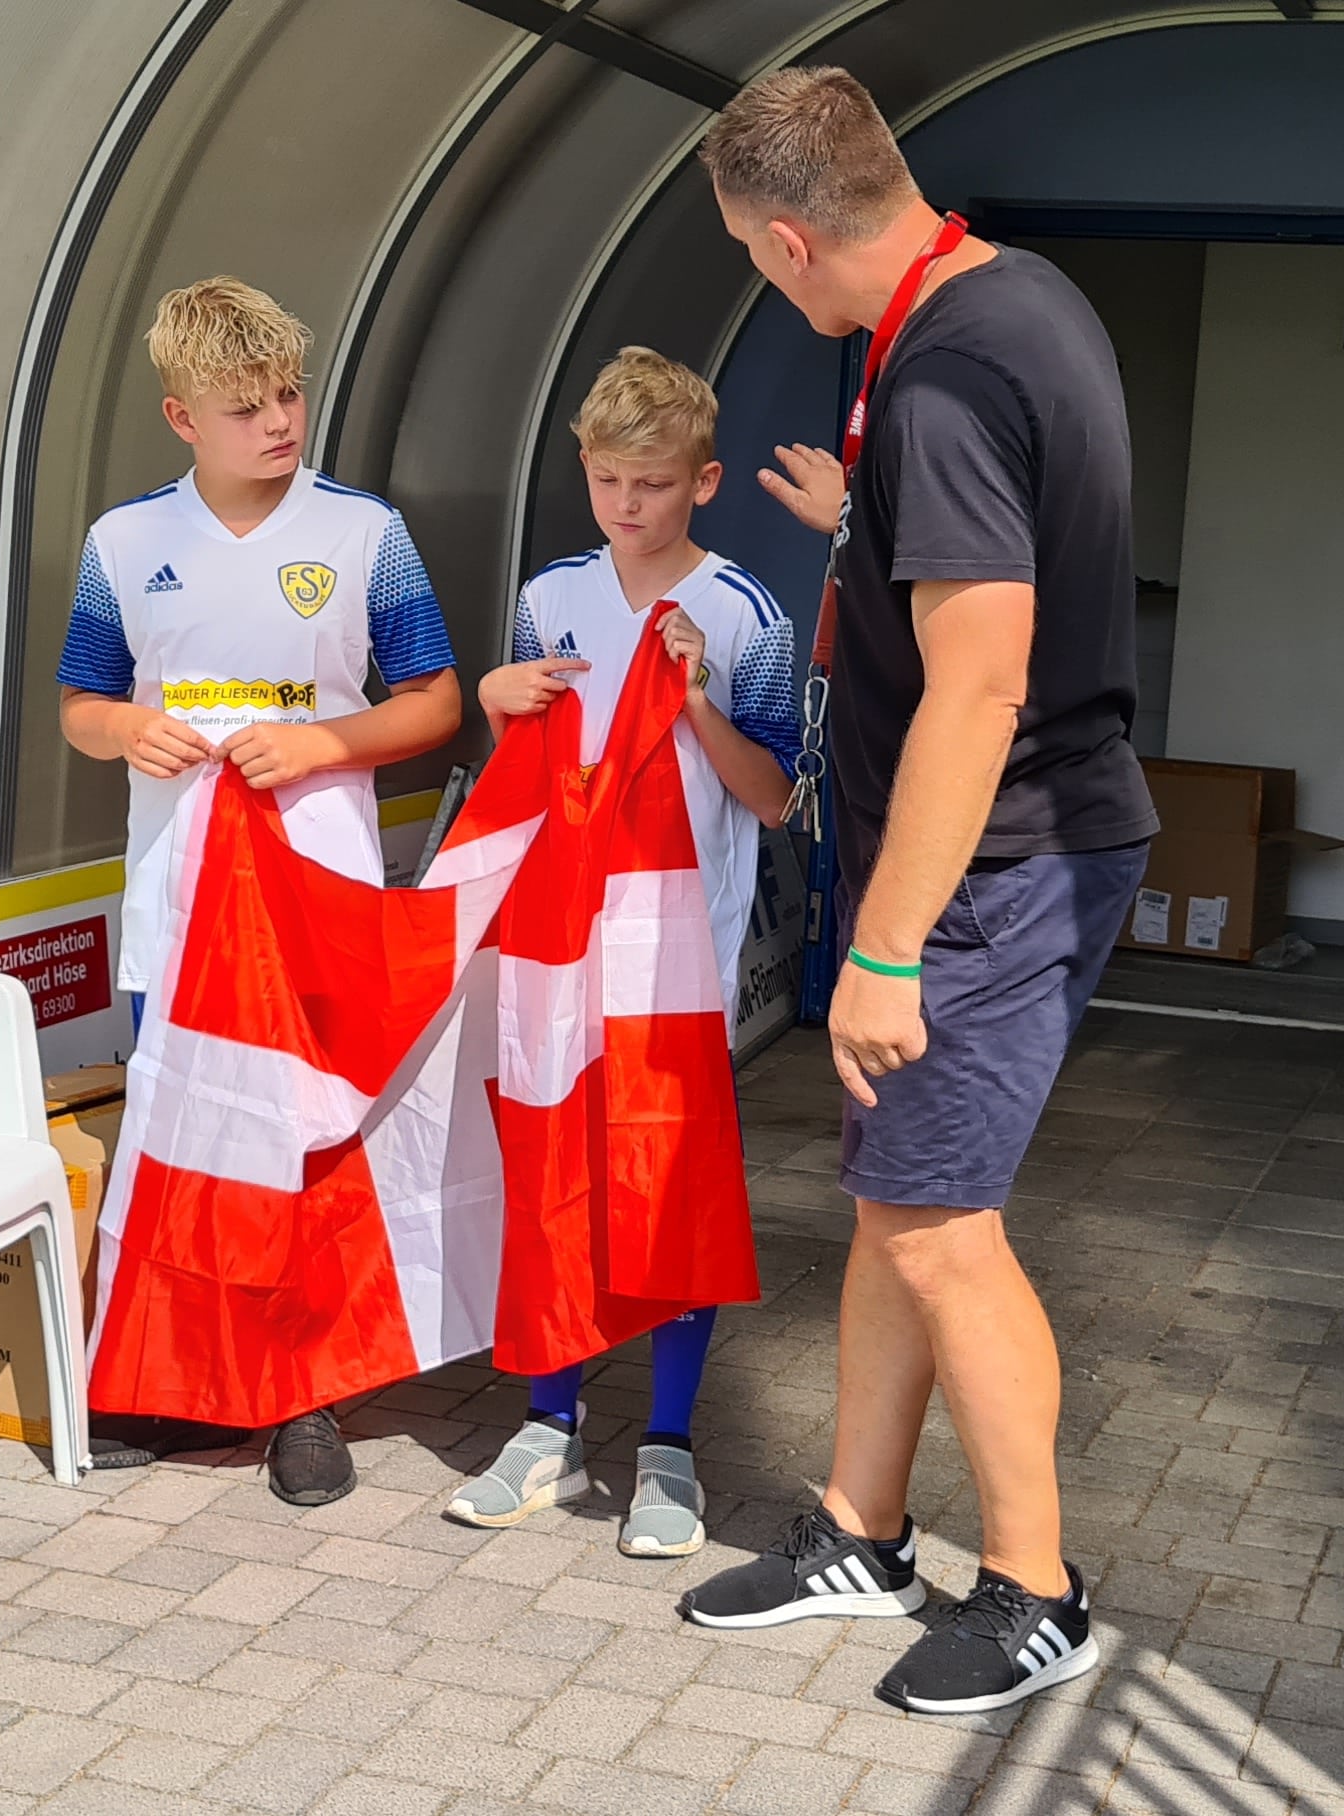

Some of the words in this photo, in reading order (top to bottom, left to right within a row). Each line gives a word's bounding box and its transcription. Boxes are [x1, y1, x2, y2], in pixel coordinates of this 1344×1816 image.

[847, 399, 866, 438] REWE
[144, 580, 184, 594] adidas
[286, 566, 331, 603] FSV
[213, 686, 269, 700] FLIESEN
[53, 961, 87, 990] Höse
[42, 993, 76, 1019] 69300
